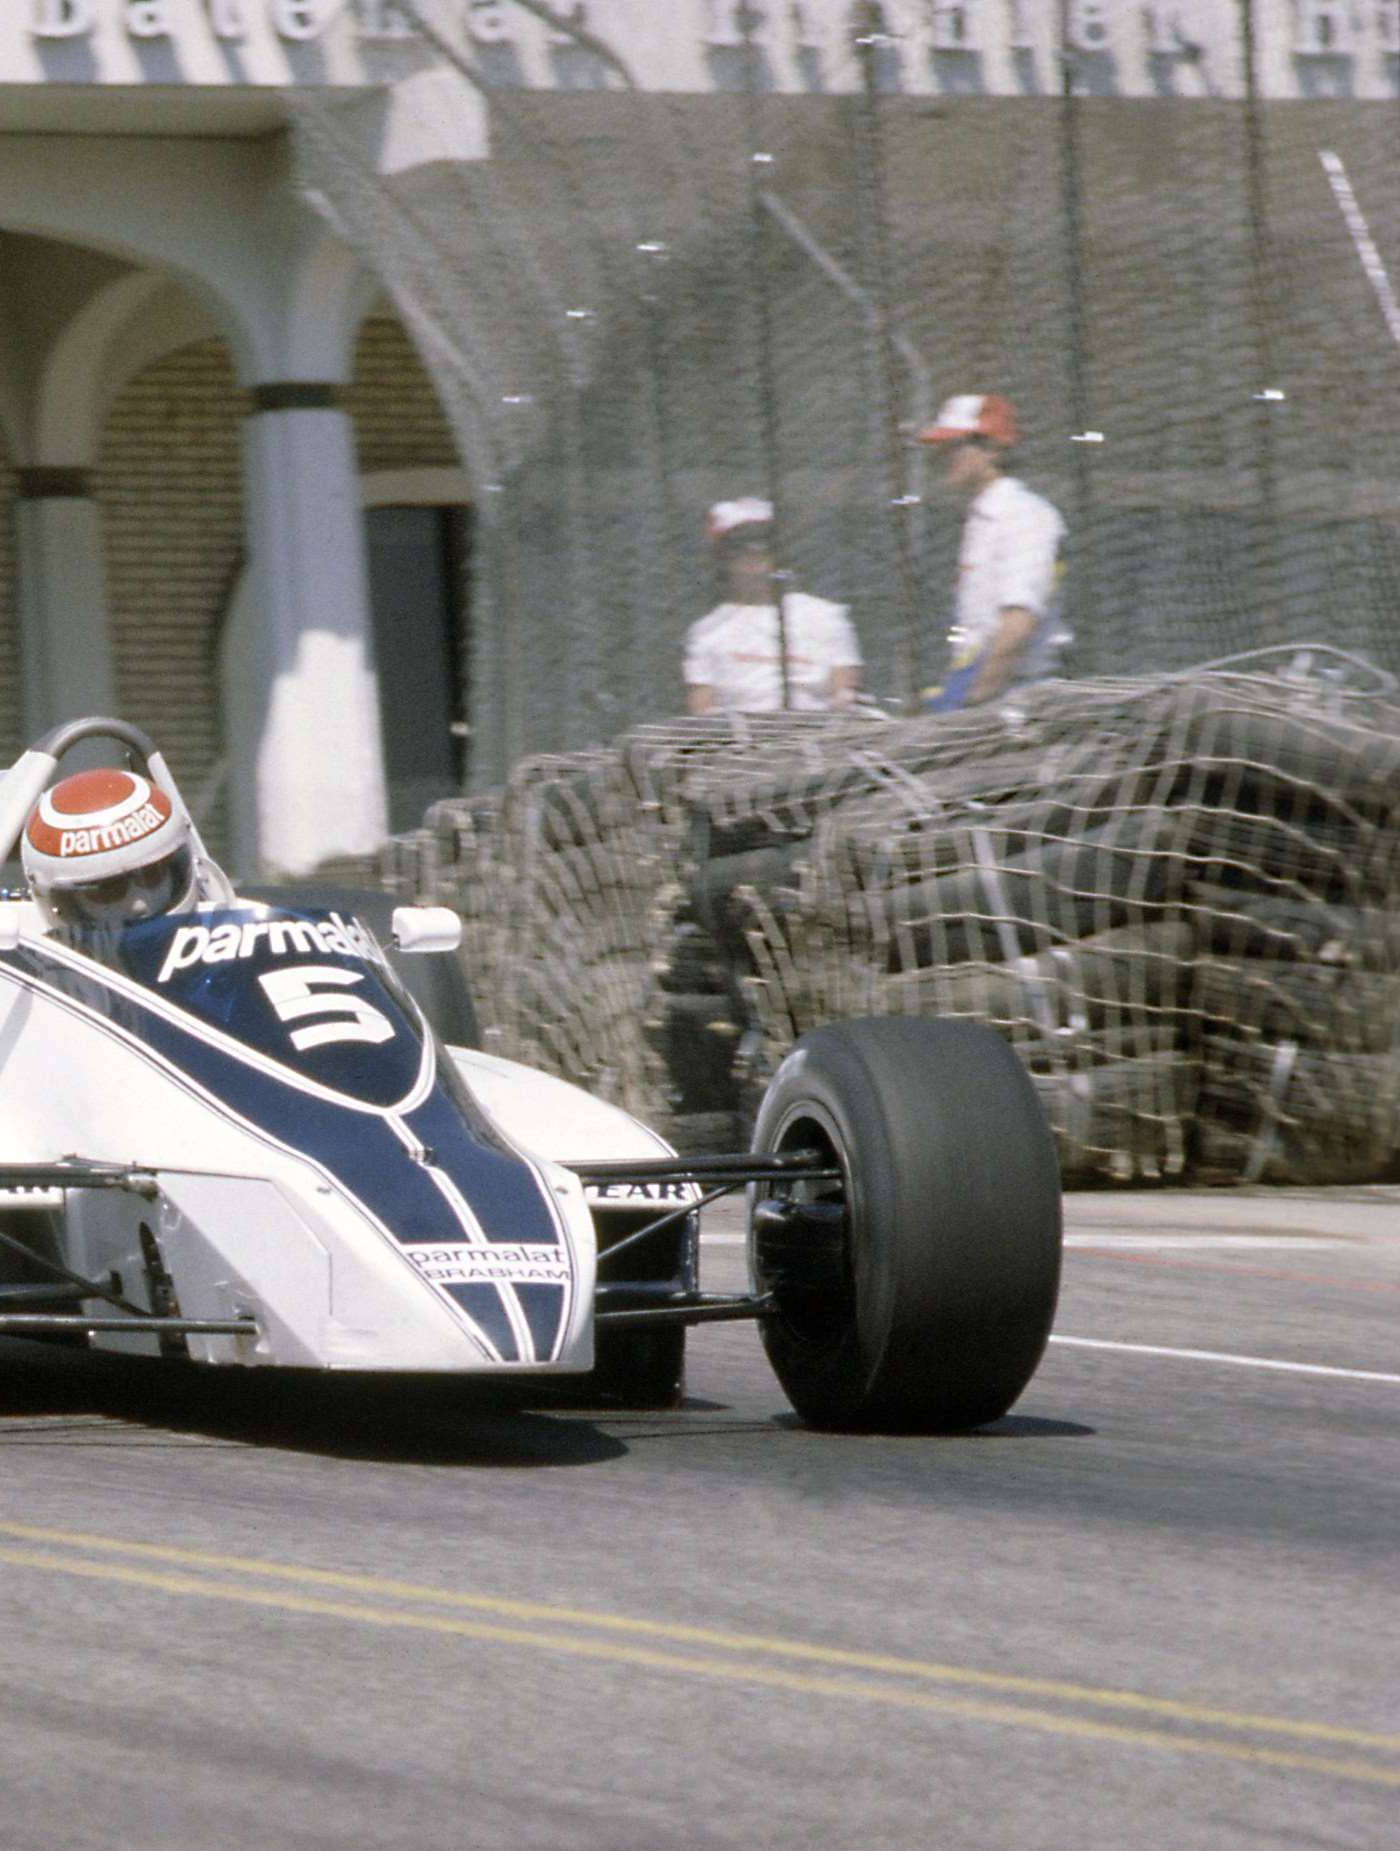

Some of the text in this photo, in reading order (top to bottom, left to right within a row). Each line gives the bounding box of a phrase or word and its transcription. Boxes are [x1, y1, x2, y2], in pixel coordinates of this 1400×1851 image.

[60, 803, 166, 857] parmalat
[258, 965, 396, 1051] 5
[406, 1246, 565, 1269] parmalat
[423, 1267, 571, 1281] BRABHAM
